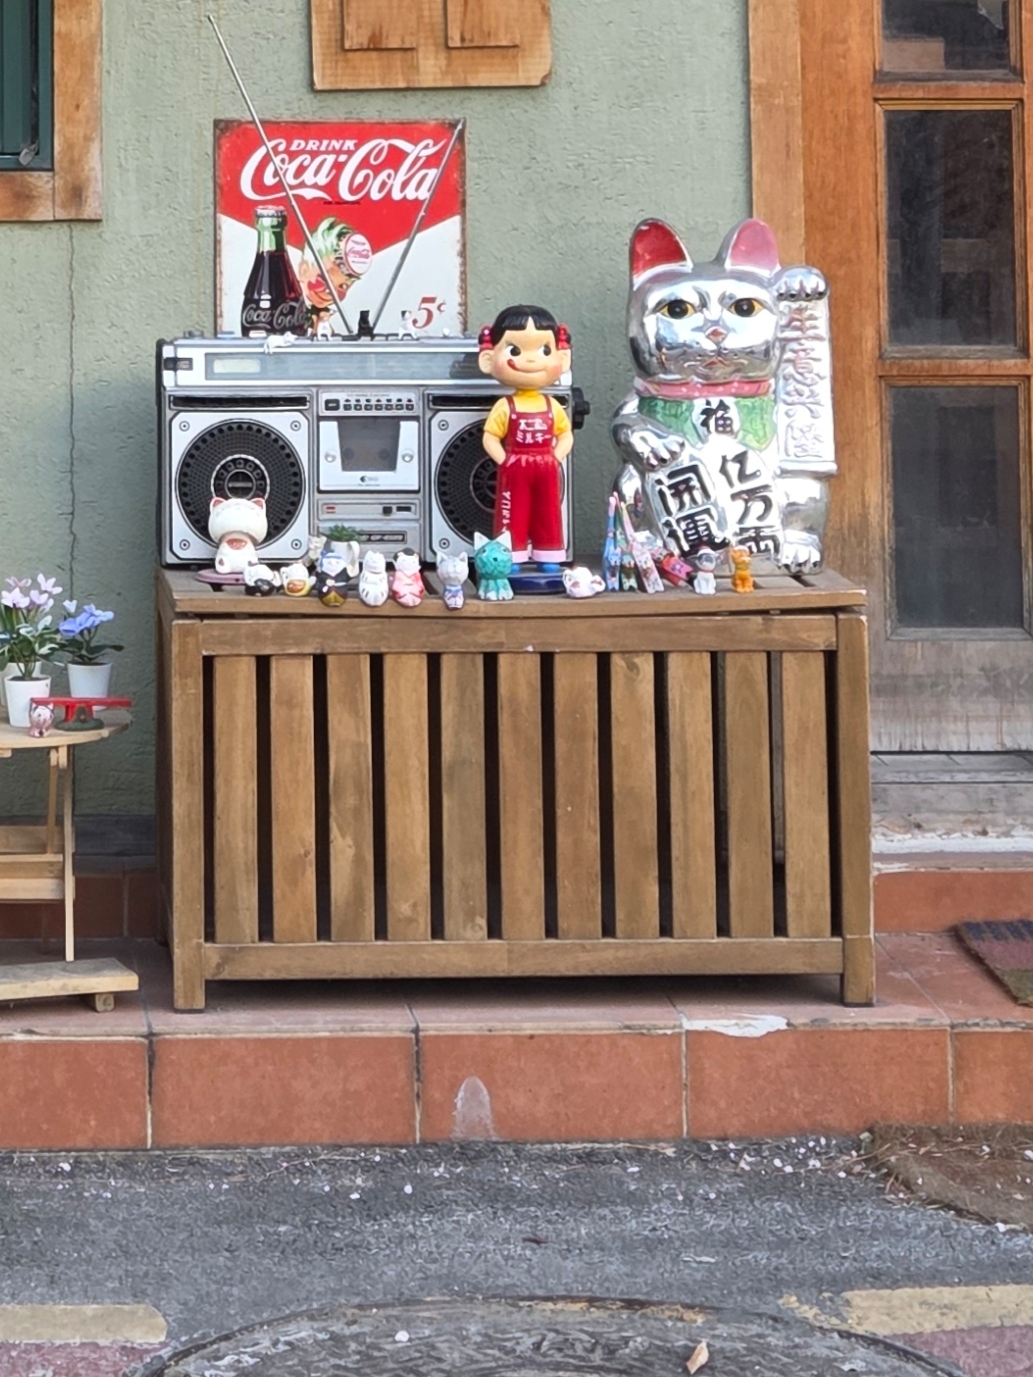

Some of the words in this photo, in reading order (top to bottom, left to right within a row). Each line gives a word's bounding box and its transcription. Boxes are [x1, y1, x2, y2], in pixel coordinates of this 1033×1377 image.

[289, 139, 359, 151] DRINK
[239, 138, 448, 202] Coca-Cola
[700, 399, 735, 436] 福
[515, 430, 552, 444] ミルキー
